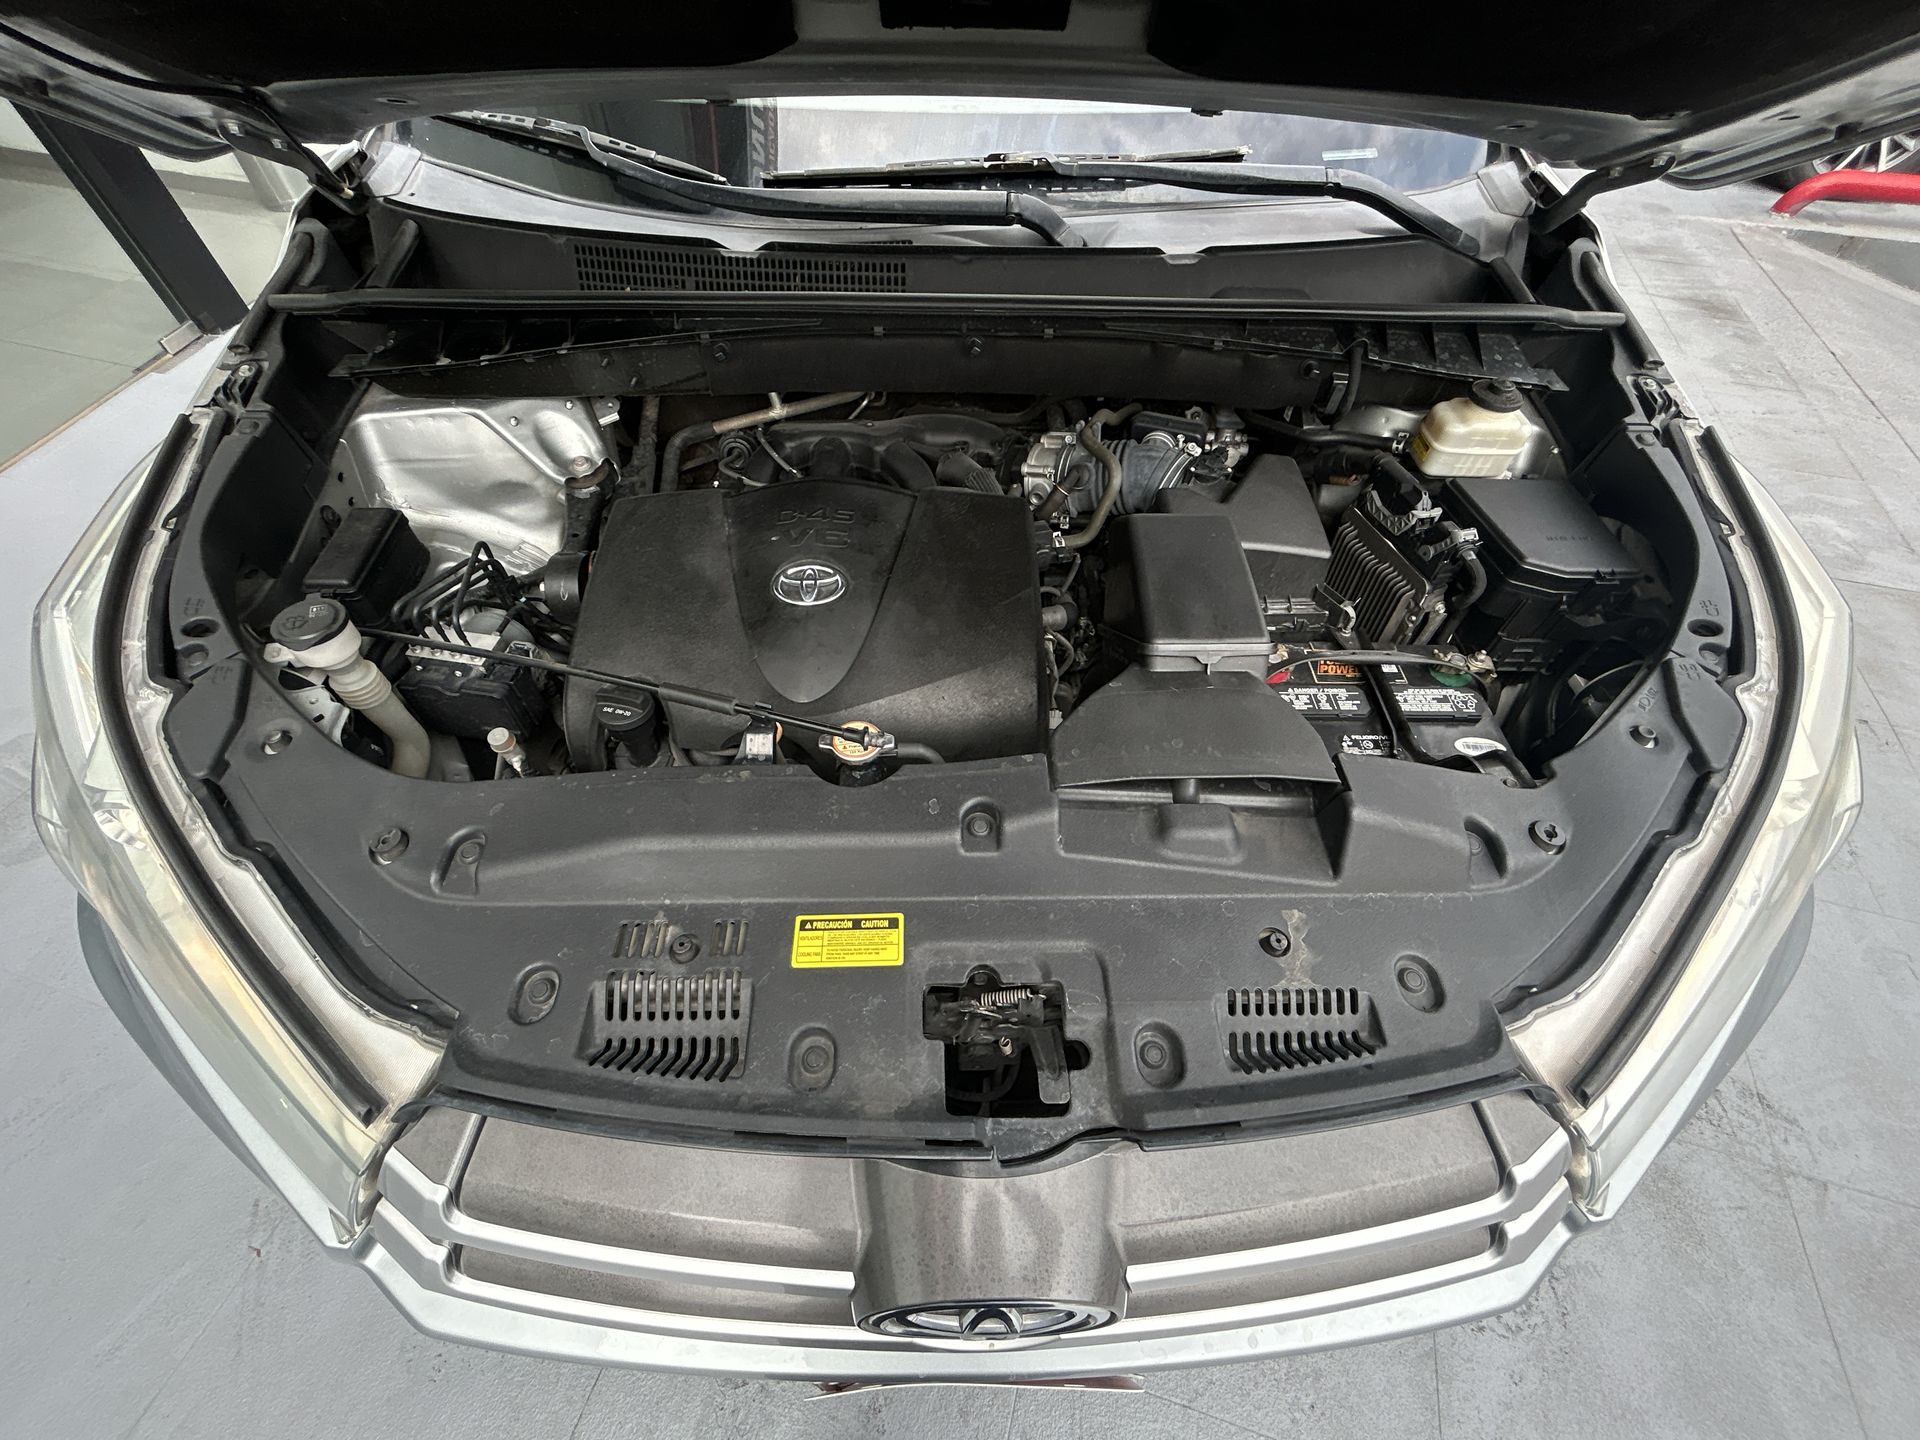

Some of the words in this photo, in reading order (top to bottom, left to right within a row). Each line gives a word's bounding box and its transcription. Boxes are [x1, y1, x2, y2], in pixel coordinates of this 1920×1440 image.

[787, 527, 850, 548] V6
[813, 920, 853, 929] PRECAUCIÓN
[861, 920, 889, 928] CAUTION
